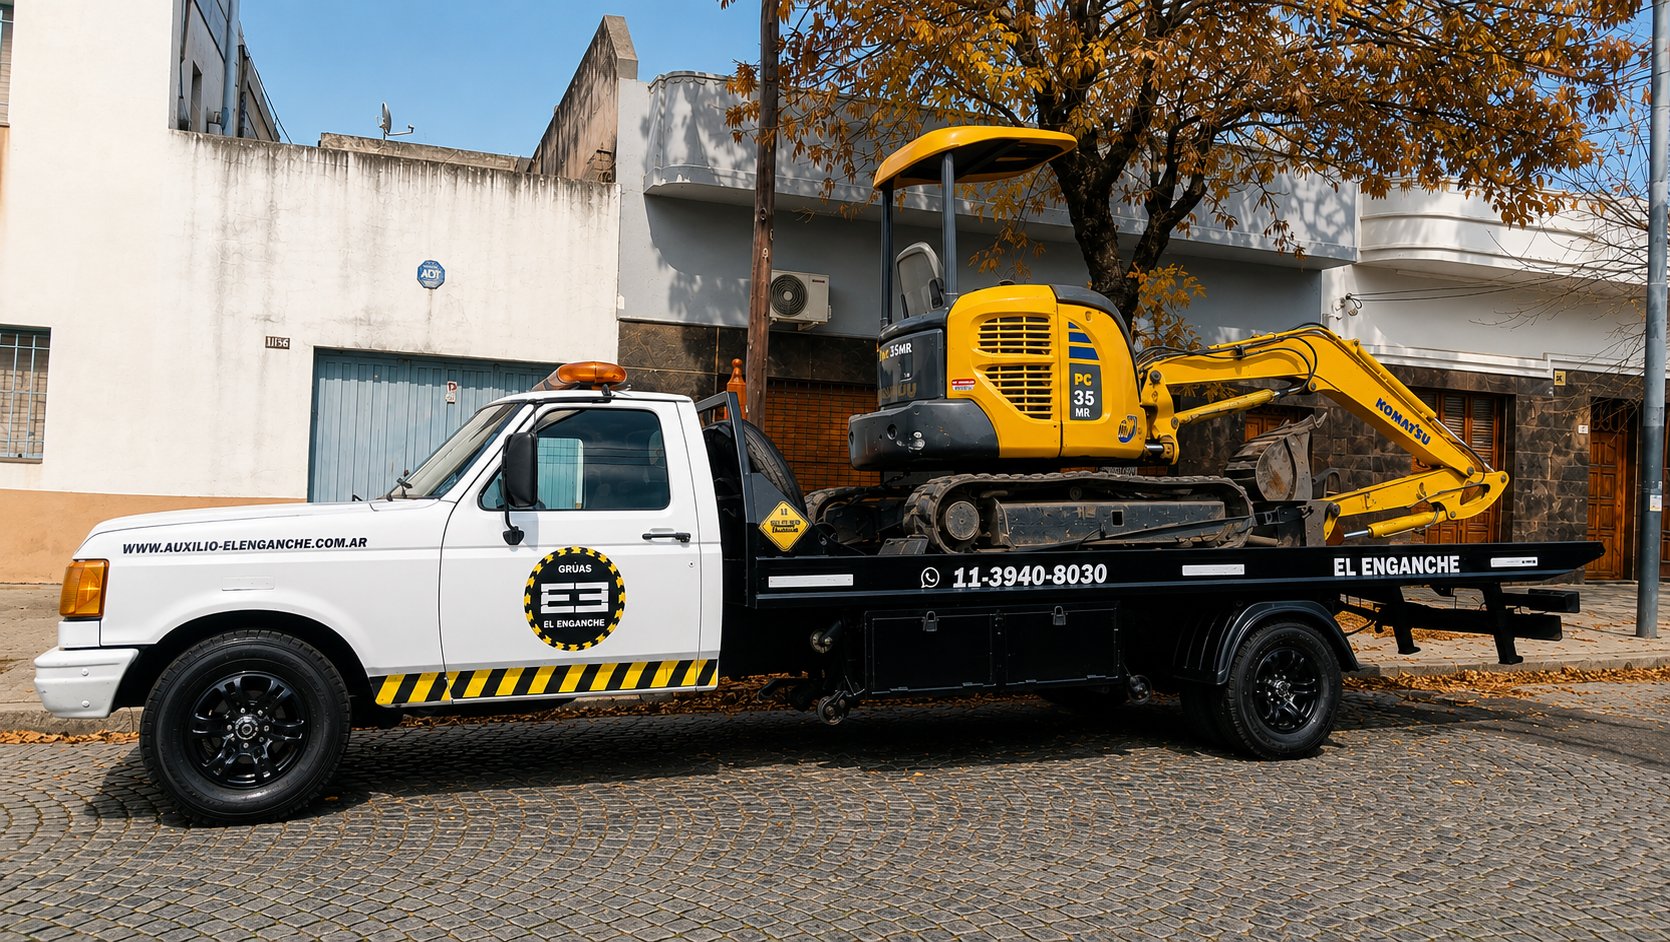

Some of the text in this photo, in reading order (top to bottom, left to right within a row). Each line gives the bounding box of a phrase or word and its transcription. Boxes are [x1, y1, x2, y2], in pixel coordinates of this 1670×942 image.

[420, 269, 441, 279] ADT
[1074, 373, 1092, 386] PC
[1073, 390, 1095, 406] 35
[1075, 407, 1090, 417] MR
[1375, 397, 1431, 445] KOMATSU
[122, 537, 368, 555] WWW.AUXILIO-ELENGANCHE.COM.AR
[1333, 555, 1460, 577] EL ENGANCHE
[952, 563, 1108, 589] 11-3940-8030
[543, 618, 605, 629] EL ENGANCHE
